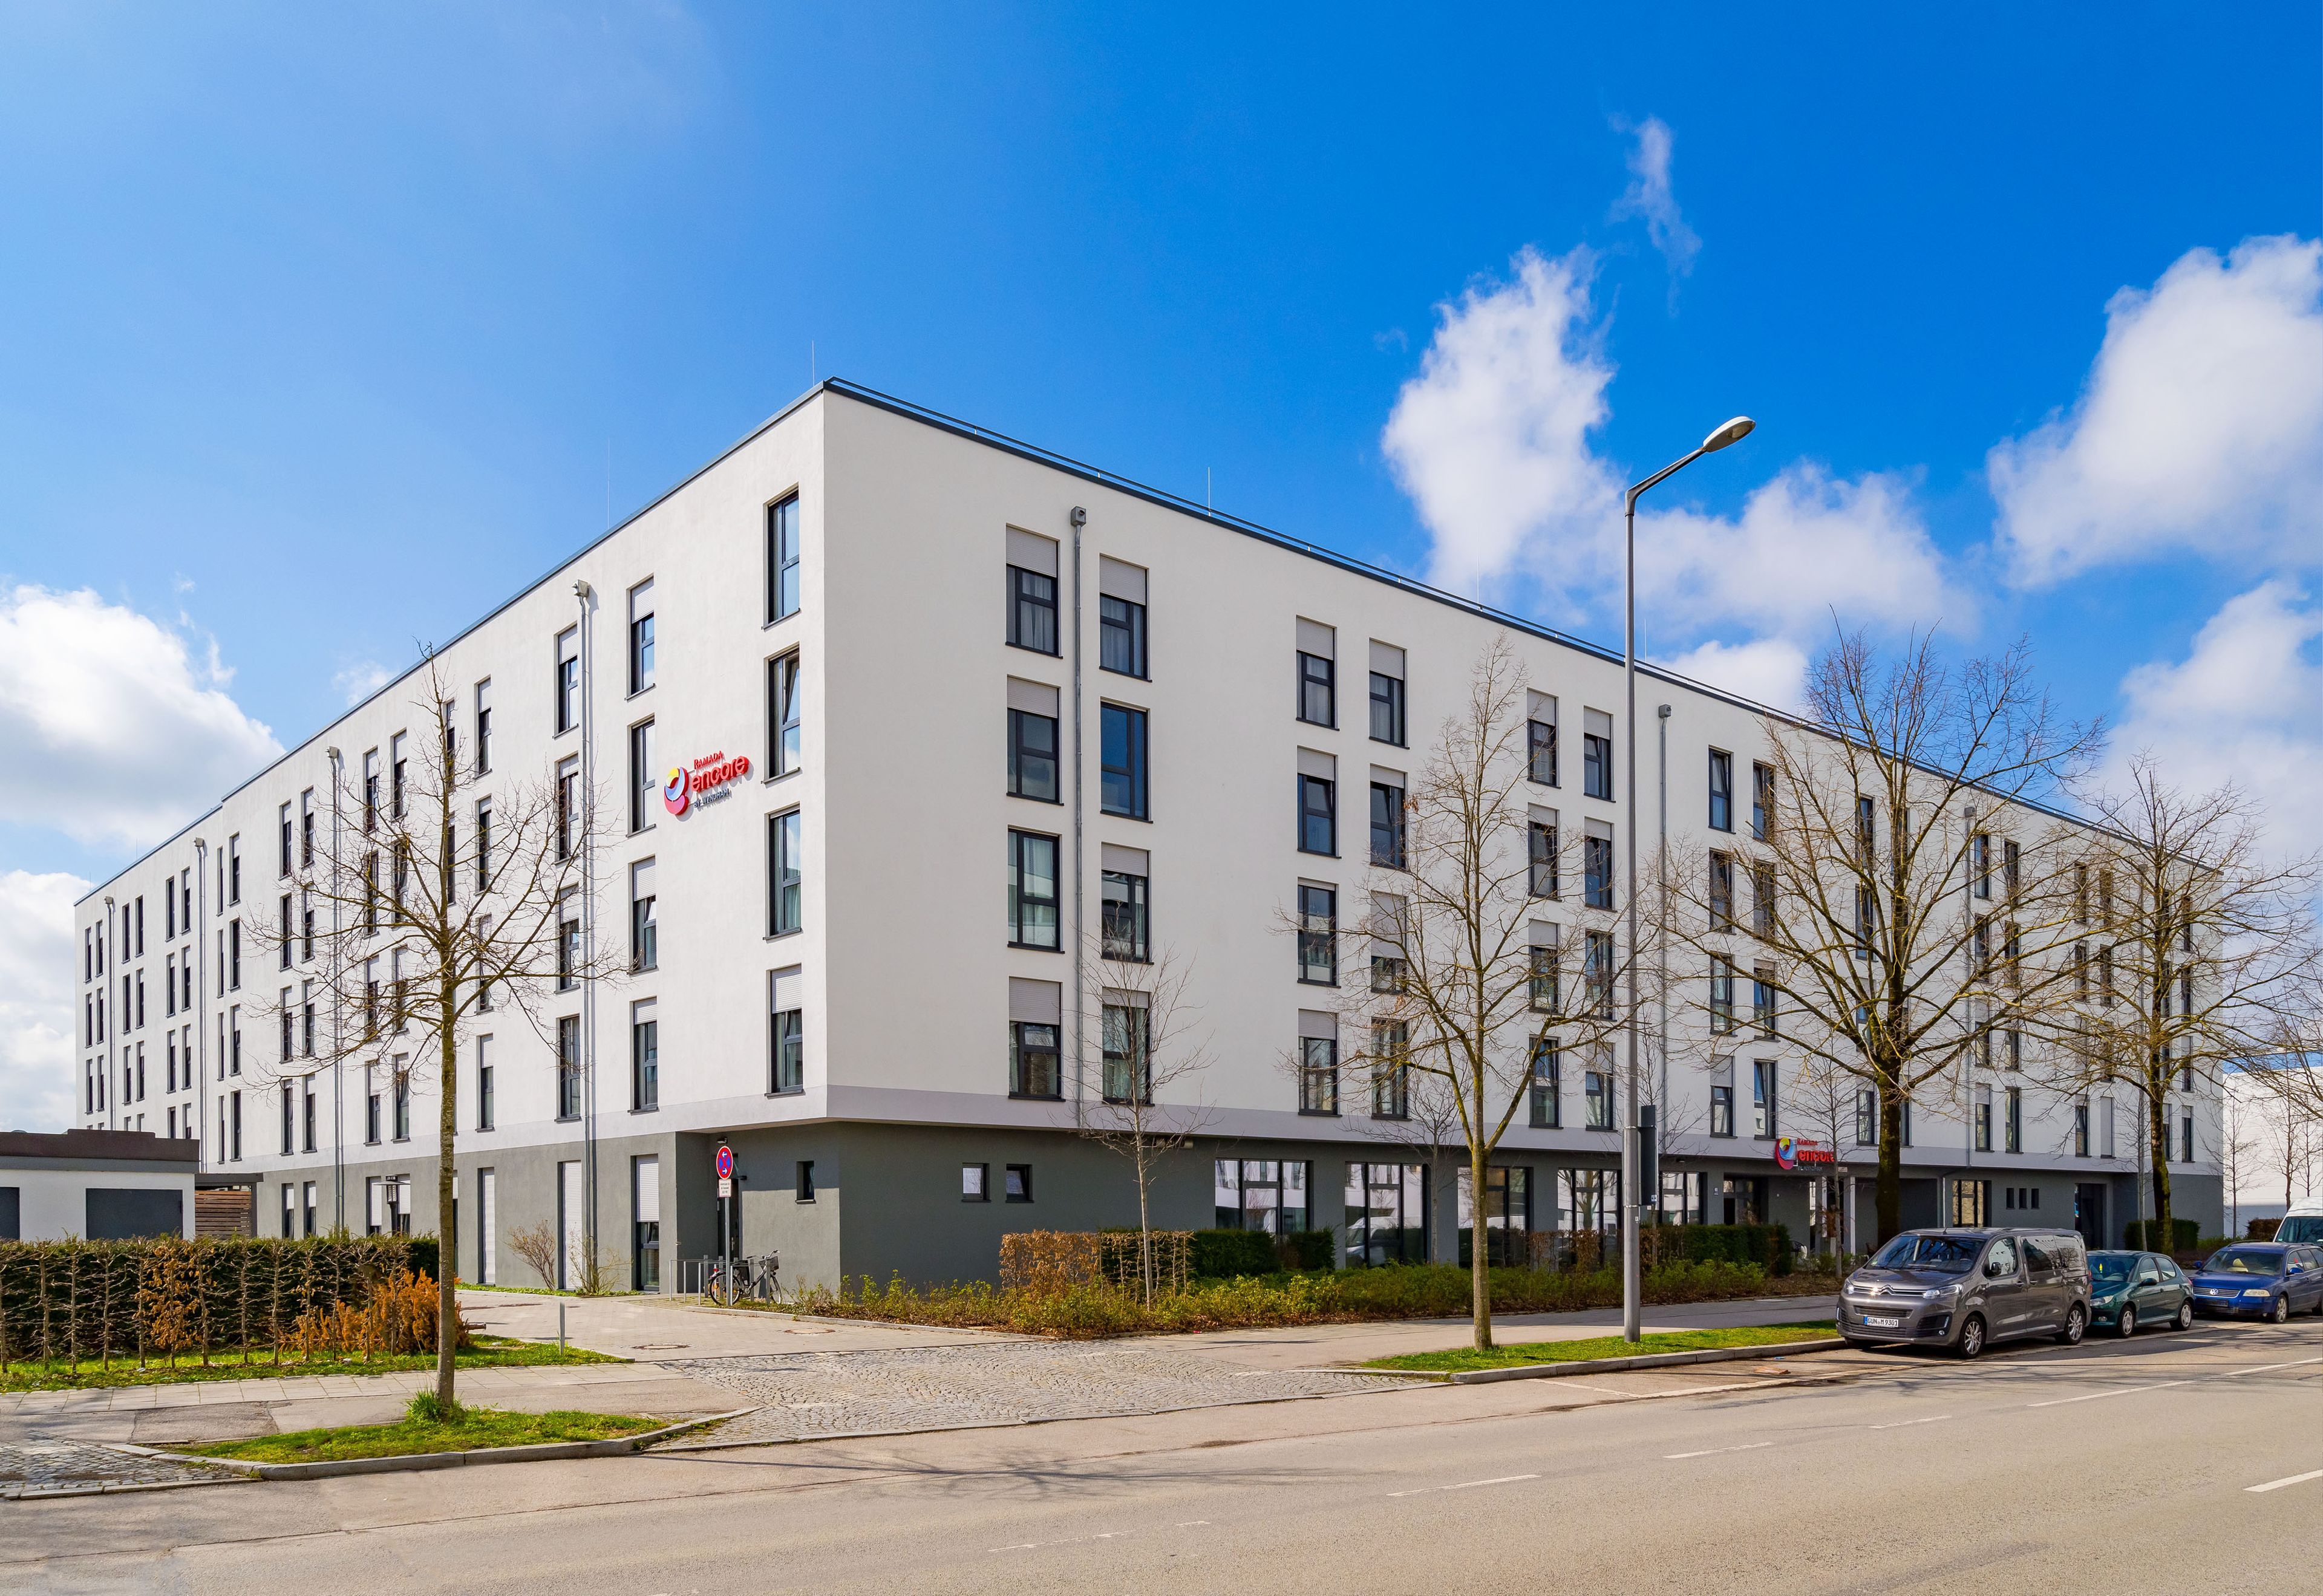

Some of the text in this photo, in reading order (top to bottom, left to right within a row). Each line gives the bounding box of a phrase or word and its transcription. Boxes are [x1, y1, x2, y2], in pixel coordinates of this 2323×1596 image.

[694, 751, 723, 769] RAMADA
[691, 755, 749, 793] encore
[694, 788, 730, 808] BY WYNDHAM
